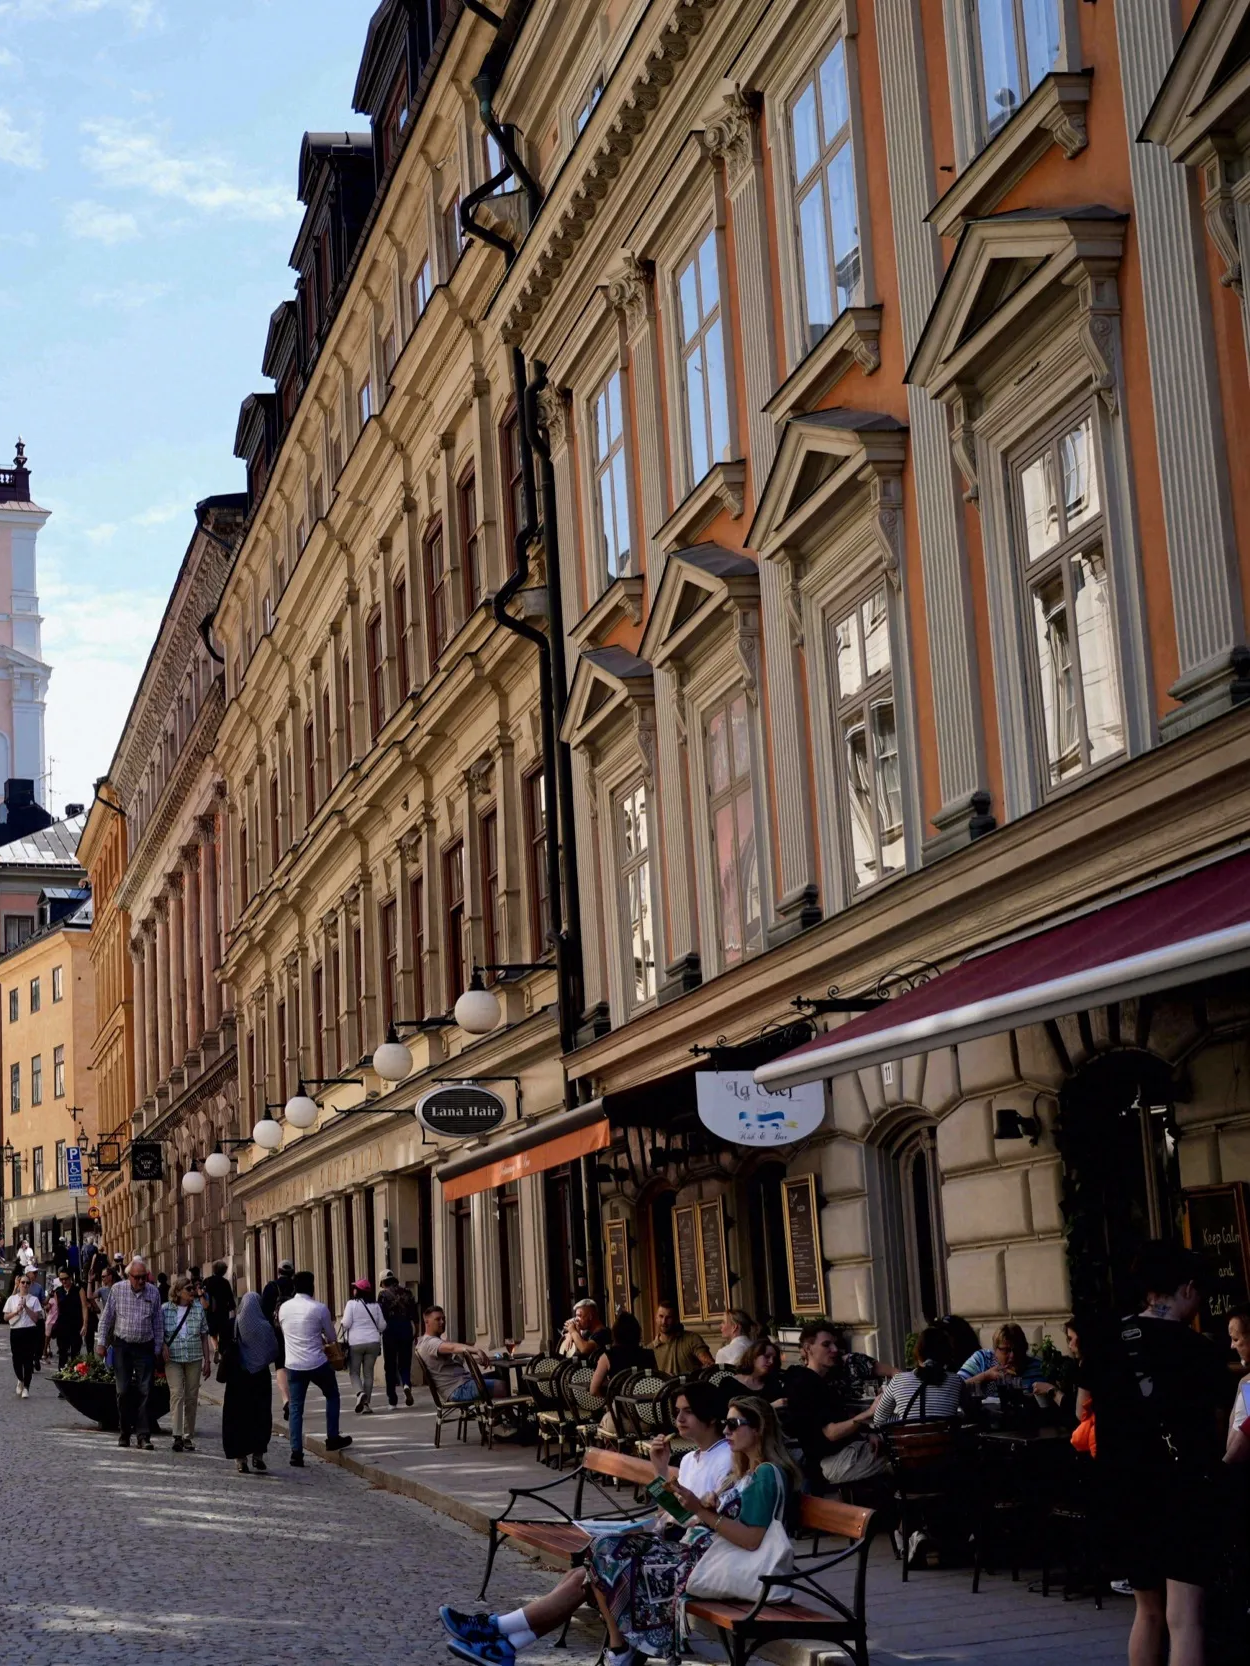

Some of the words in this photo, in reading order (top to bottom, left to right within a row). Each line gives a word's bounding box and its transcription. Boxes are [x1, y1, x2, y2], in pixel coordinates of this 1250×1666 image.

[885, 1065, 891, 1081] 11
[431, 1106, 463, 1116] Lana
[468, 1105, 498, 1116] Hair
[70, 1148, 78, 1160] P
[1202, 1227, 1221, 1255] Keep
[1218, 1261, 1234, 1277] and
[1209, 1294, 1223, 1316] Eat
